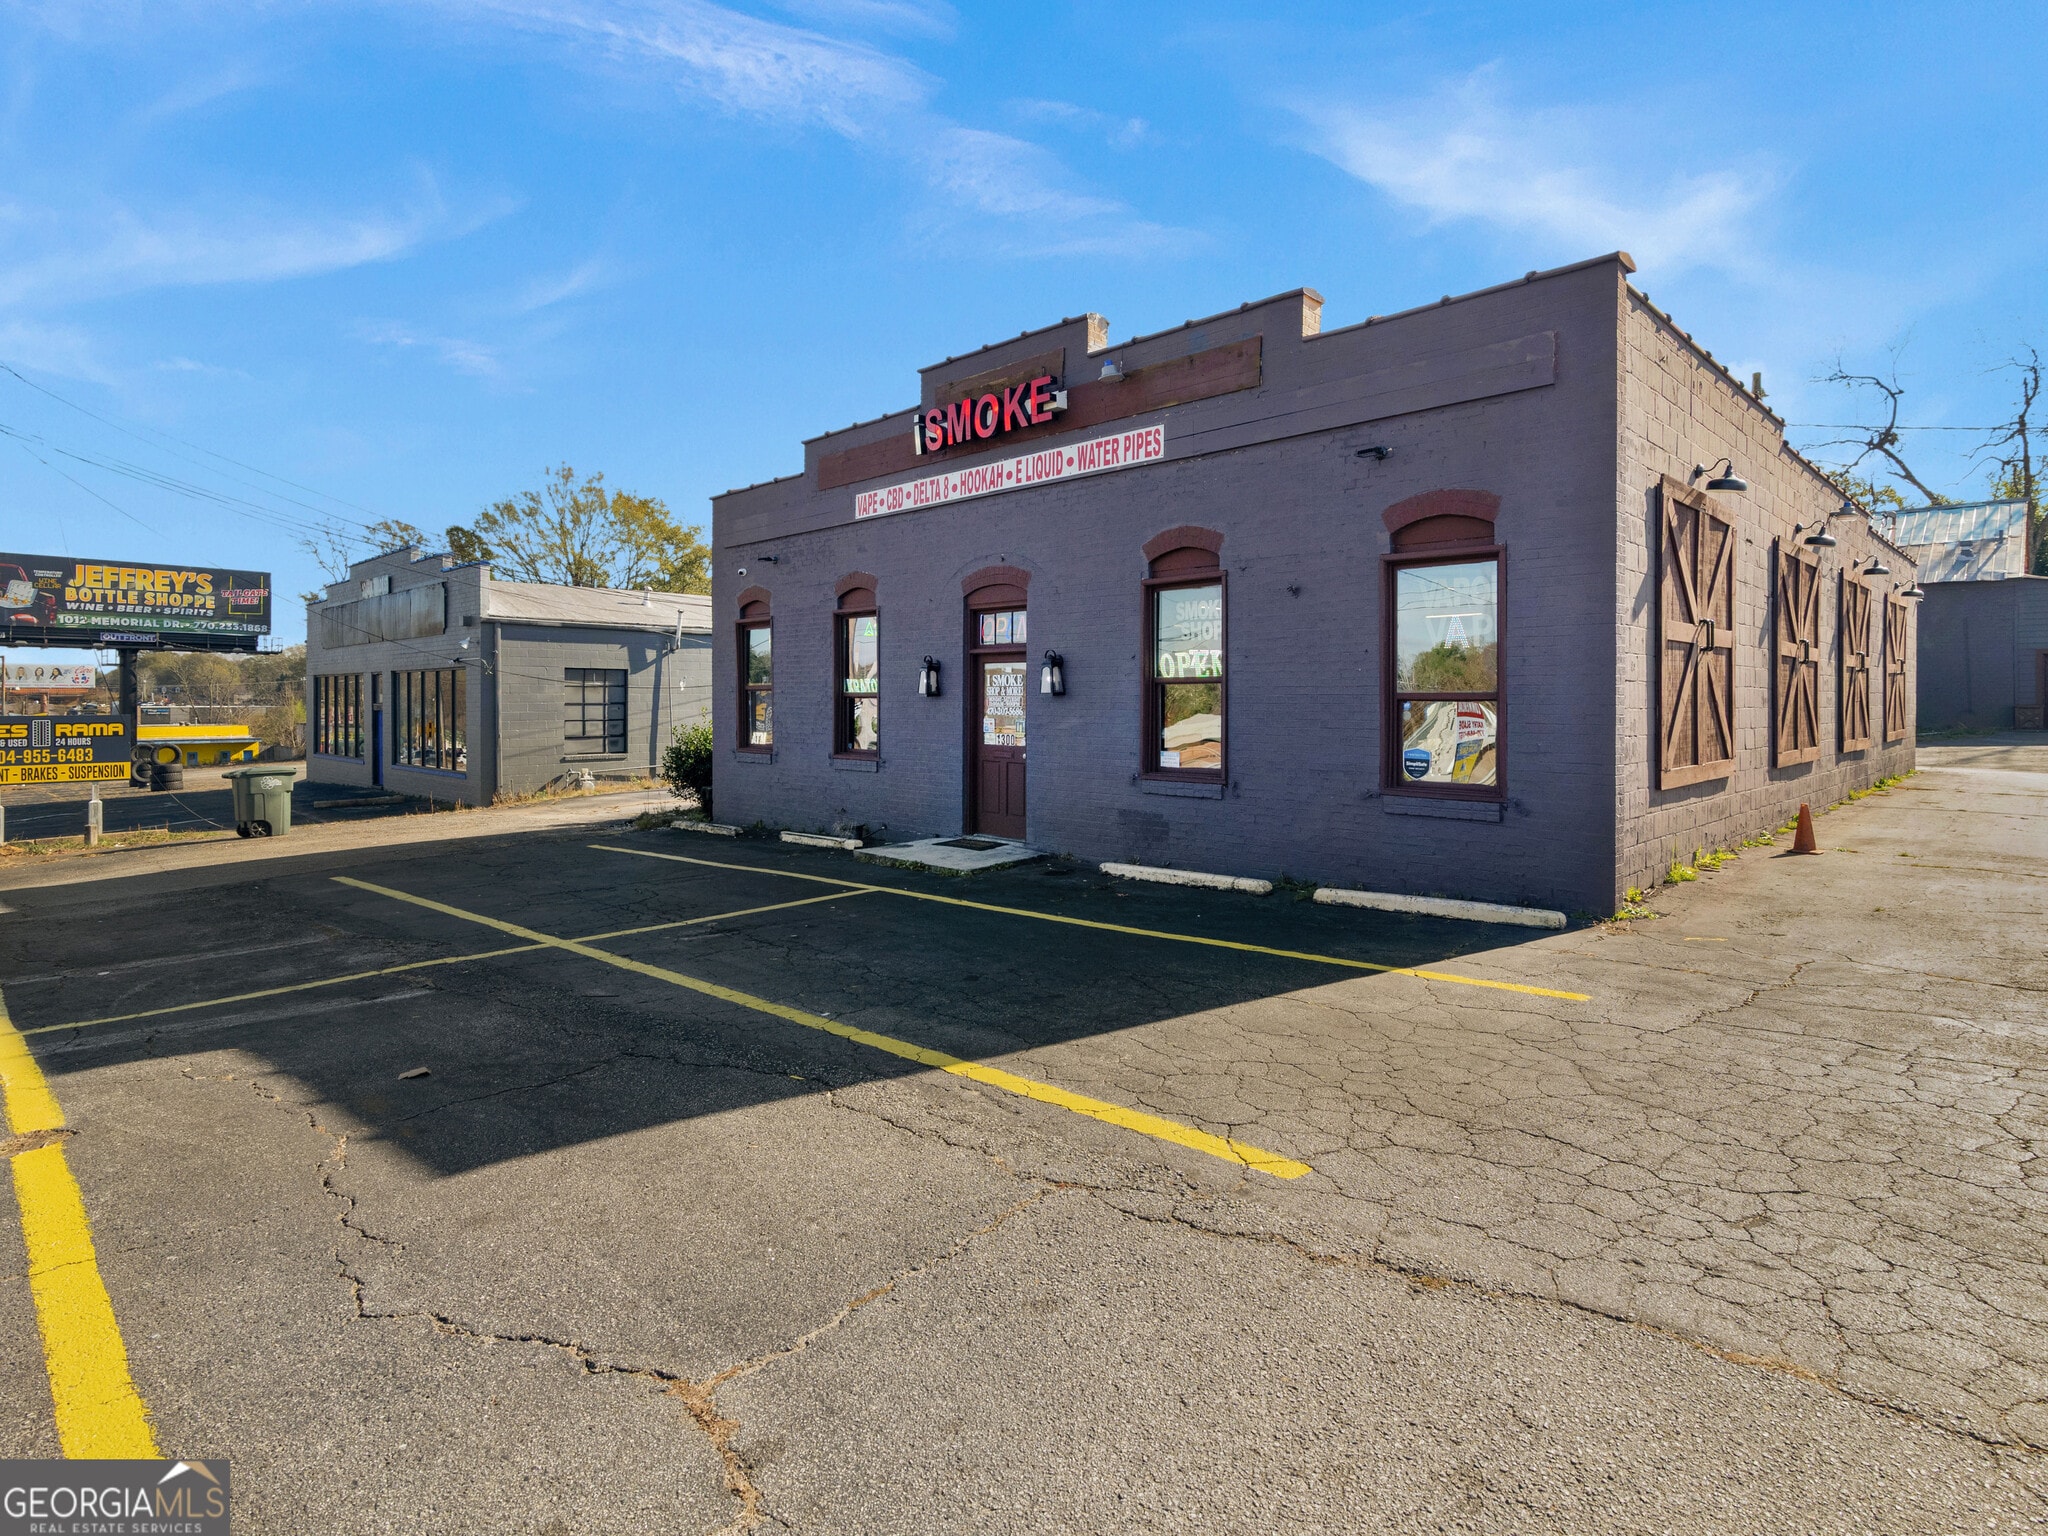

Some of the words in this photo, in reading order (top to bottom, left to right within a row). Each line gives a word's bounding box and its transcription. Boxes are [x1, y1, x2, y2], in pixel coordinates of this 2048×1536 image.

[857, 491, 878, 517] VAPE
[886, 487, 904, 512] CBD
[913, 479, 941, 506] DELTA
[943, 476, 950, 500] 8
[960, 463, 1004, 496] HOOKAH
[1015, 459, 1023, 484] E
[1025, 449, 1064, 482] LIQUID
[1077, 437, 1120, 472] WATER
[1123, 427, 1161, 462] PIPES
[68, 564, 213, 595] JEFFREY'S
[65, 587, 139, 605] BOTTLE
[144, 591, 216, 609] SHOPPE
[220, 588, 270, 598] TAILGATE
[231, 597, 259, 605] TIME!
[66, 602, 105, 612] WINE
[116, 604, 152, 614] BEER
[163, 607, 215, 617] SPIRITS
[1175, 600, 1221, 620] SMOK
[58, 614, 88, 625] 1012
[91, 616, 160, 628] MEMORIAL
[163, 618, 184, 628] DR.
[102, 632, 157, 642] OUTFRONT
[992, 673, 1024, 687] SMOKE
[55, 723, 124, 737] RAMA
[8, 739, 28, 747] USED
[55, 738, 66, 746] 24
[68, 737, 92, 746] HOURS
[996, 734, 1015, 746] 1300
[21, 766, 58, 781] BRAKES
[68, 764, 125, 779] SUSPENSION
